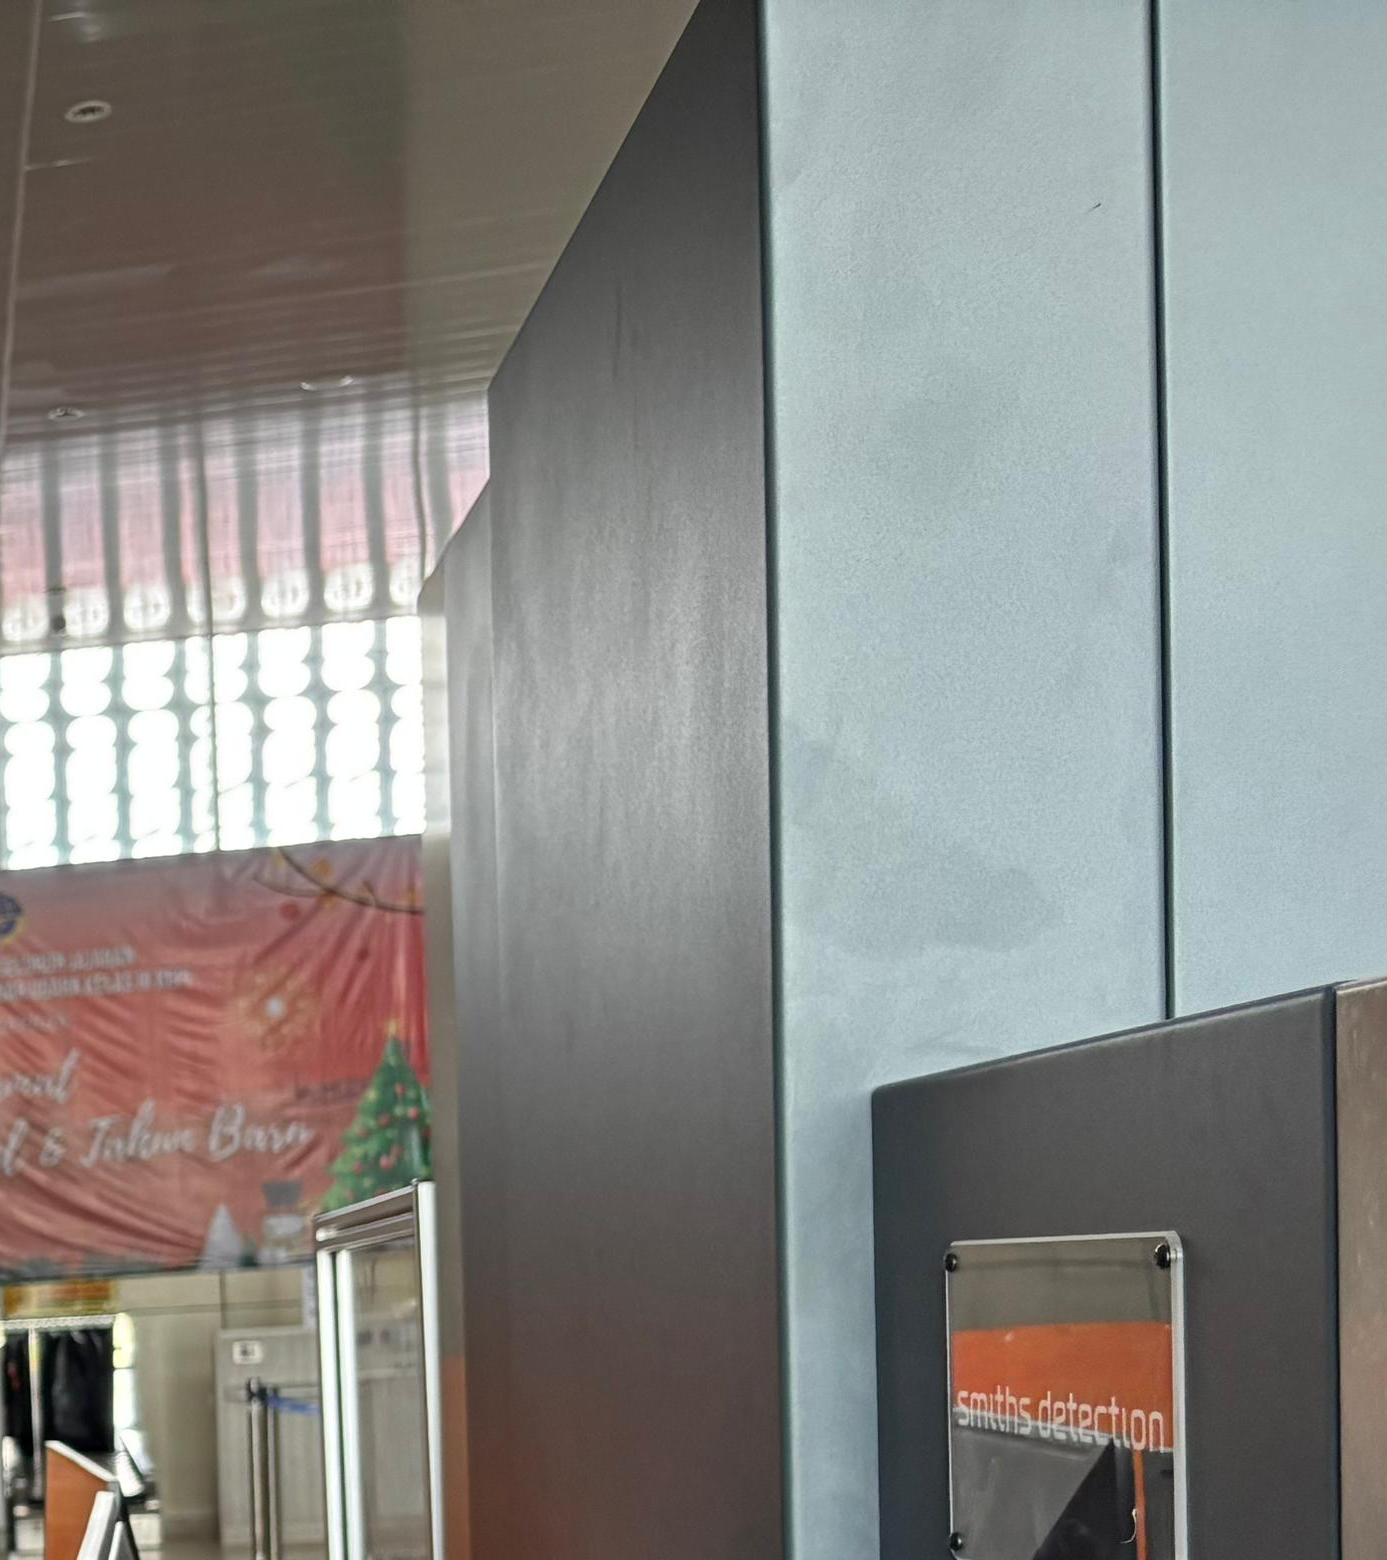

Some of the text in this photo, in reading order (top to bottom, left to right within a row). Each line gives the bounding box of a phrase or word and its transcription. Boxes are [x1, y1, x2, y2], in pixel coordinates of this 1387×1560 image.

[39, 1126, 67, 1168] &
[81, 1098, 197, 1169] Tahun
[208, 1102, 314, 1163] Baru
[957, 1384, 1165, 1453] smiths detection
